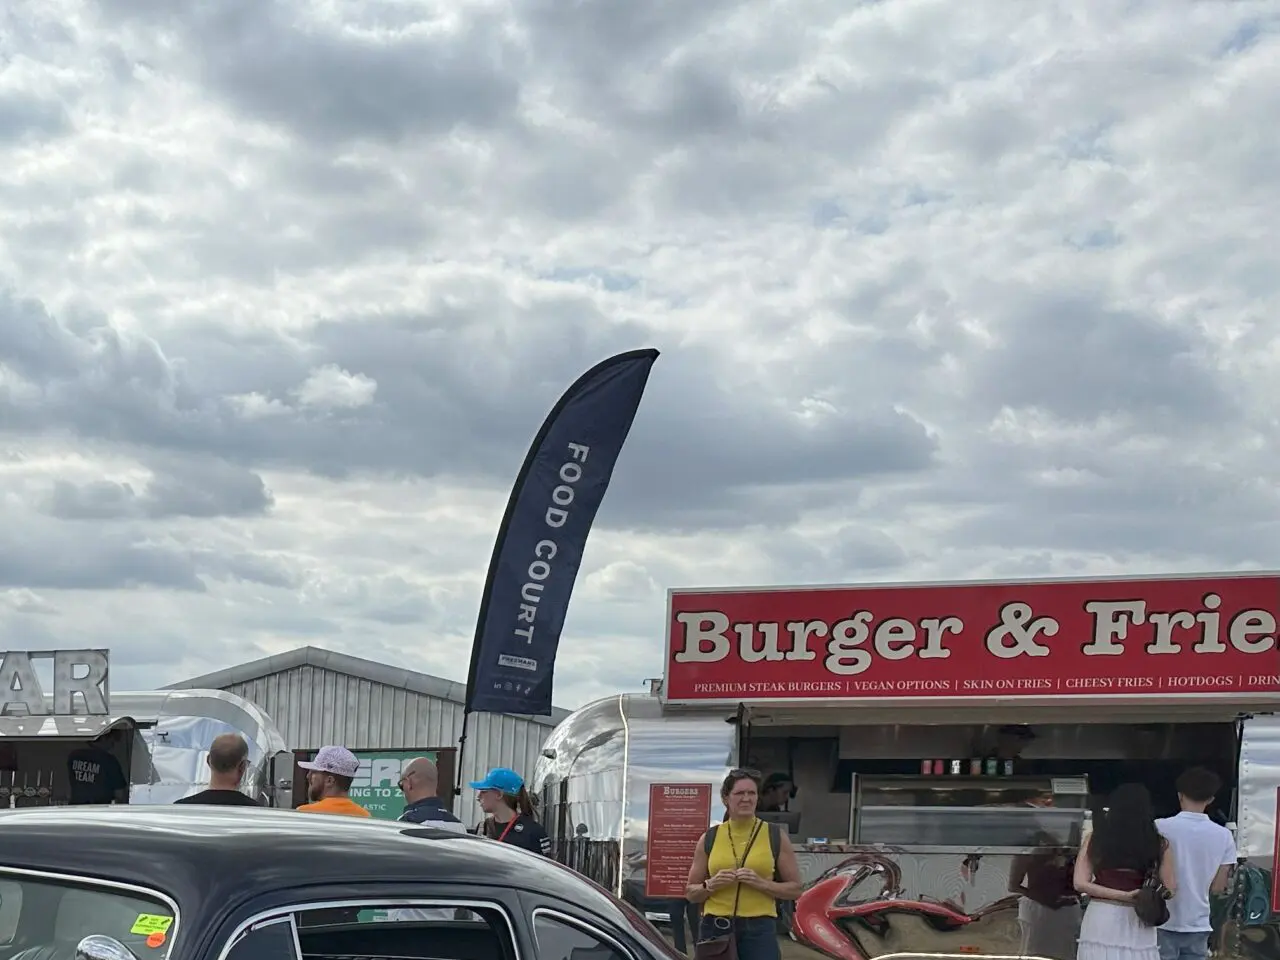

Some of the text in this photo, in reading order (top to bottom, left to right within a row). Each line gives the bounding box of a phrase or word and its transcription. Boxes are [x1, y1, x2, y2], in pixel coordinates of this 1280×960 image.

[514, 441, 590, 644] FOOD COURT
[673, 592, 1280, 675] Burger & Frie
[694, 681, 841, 692] PREMIUM STEAK BURGERS
[854, 680, 950, 690] VEGAN OPTIONS
[963, 678, 1052, 689] SKIN ON FRIES
[1065, 677, 1153, 688] CHEESY FRIES
[1168, 676, 1233, 687] HOTDOGS
[72, 760, 101, 774] DREAM
[75, 770, 95, 783] TEAM
[349, 788, 371, 797] ING
[374, 788, 391, 797] TO
[363, 803, 387, 811] ASTIC
